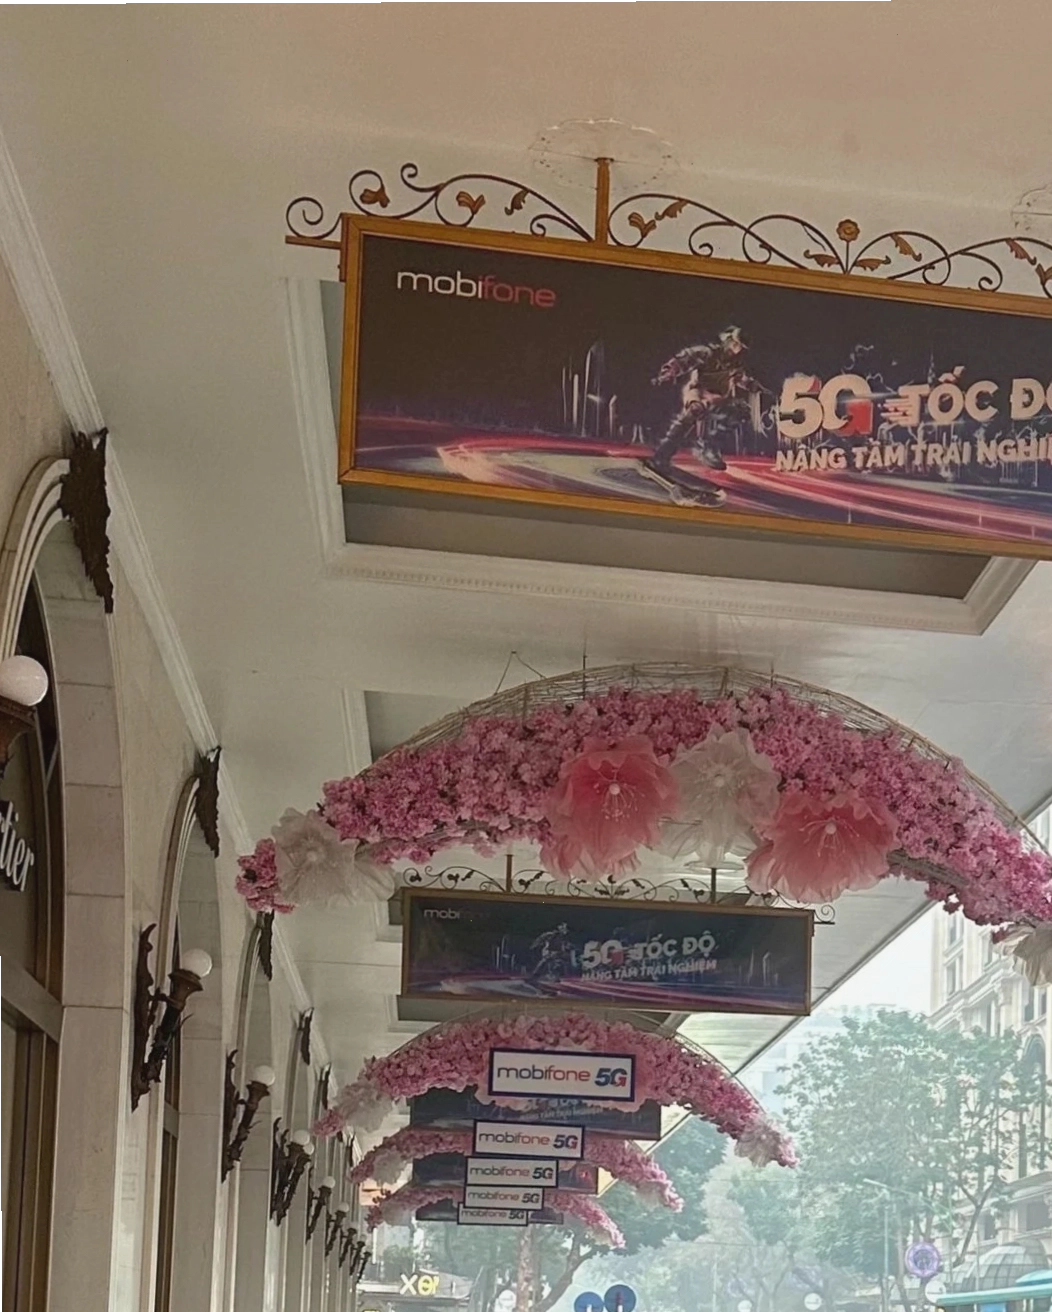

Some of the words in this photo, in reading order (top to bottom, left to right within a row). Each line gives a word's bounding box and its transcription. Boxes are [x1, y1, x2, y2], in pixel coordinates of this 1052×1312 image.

[397, 270, 556, 307] mobifone
[778, 373, 873, 437] 5G
[895, 365, 999, 427] TỐC
[776, 443, 847, 471] NÂNG
[0, 801, 34, 892] tier
[582, 939, 624, 968] 5G
[497, 1065, 590, 1082] mobifone
[594, 1068, 628, 1087] 5G
[479, 1132, 550, 1145] mobifone
[553, 1134, 578, 1149] 5G
[470, 1165, 530, 1177] mobifone
[532, 1167, 554, 1179] 5G
[468, 1190, 519, 1201] mobifone
[522, 1193, 540, 1204] 5G
